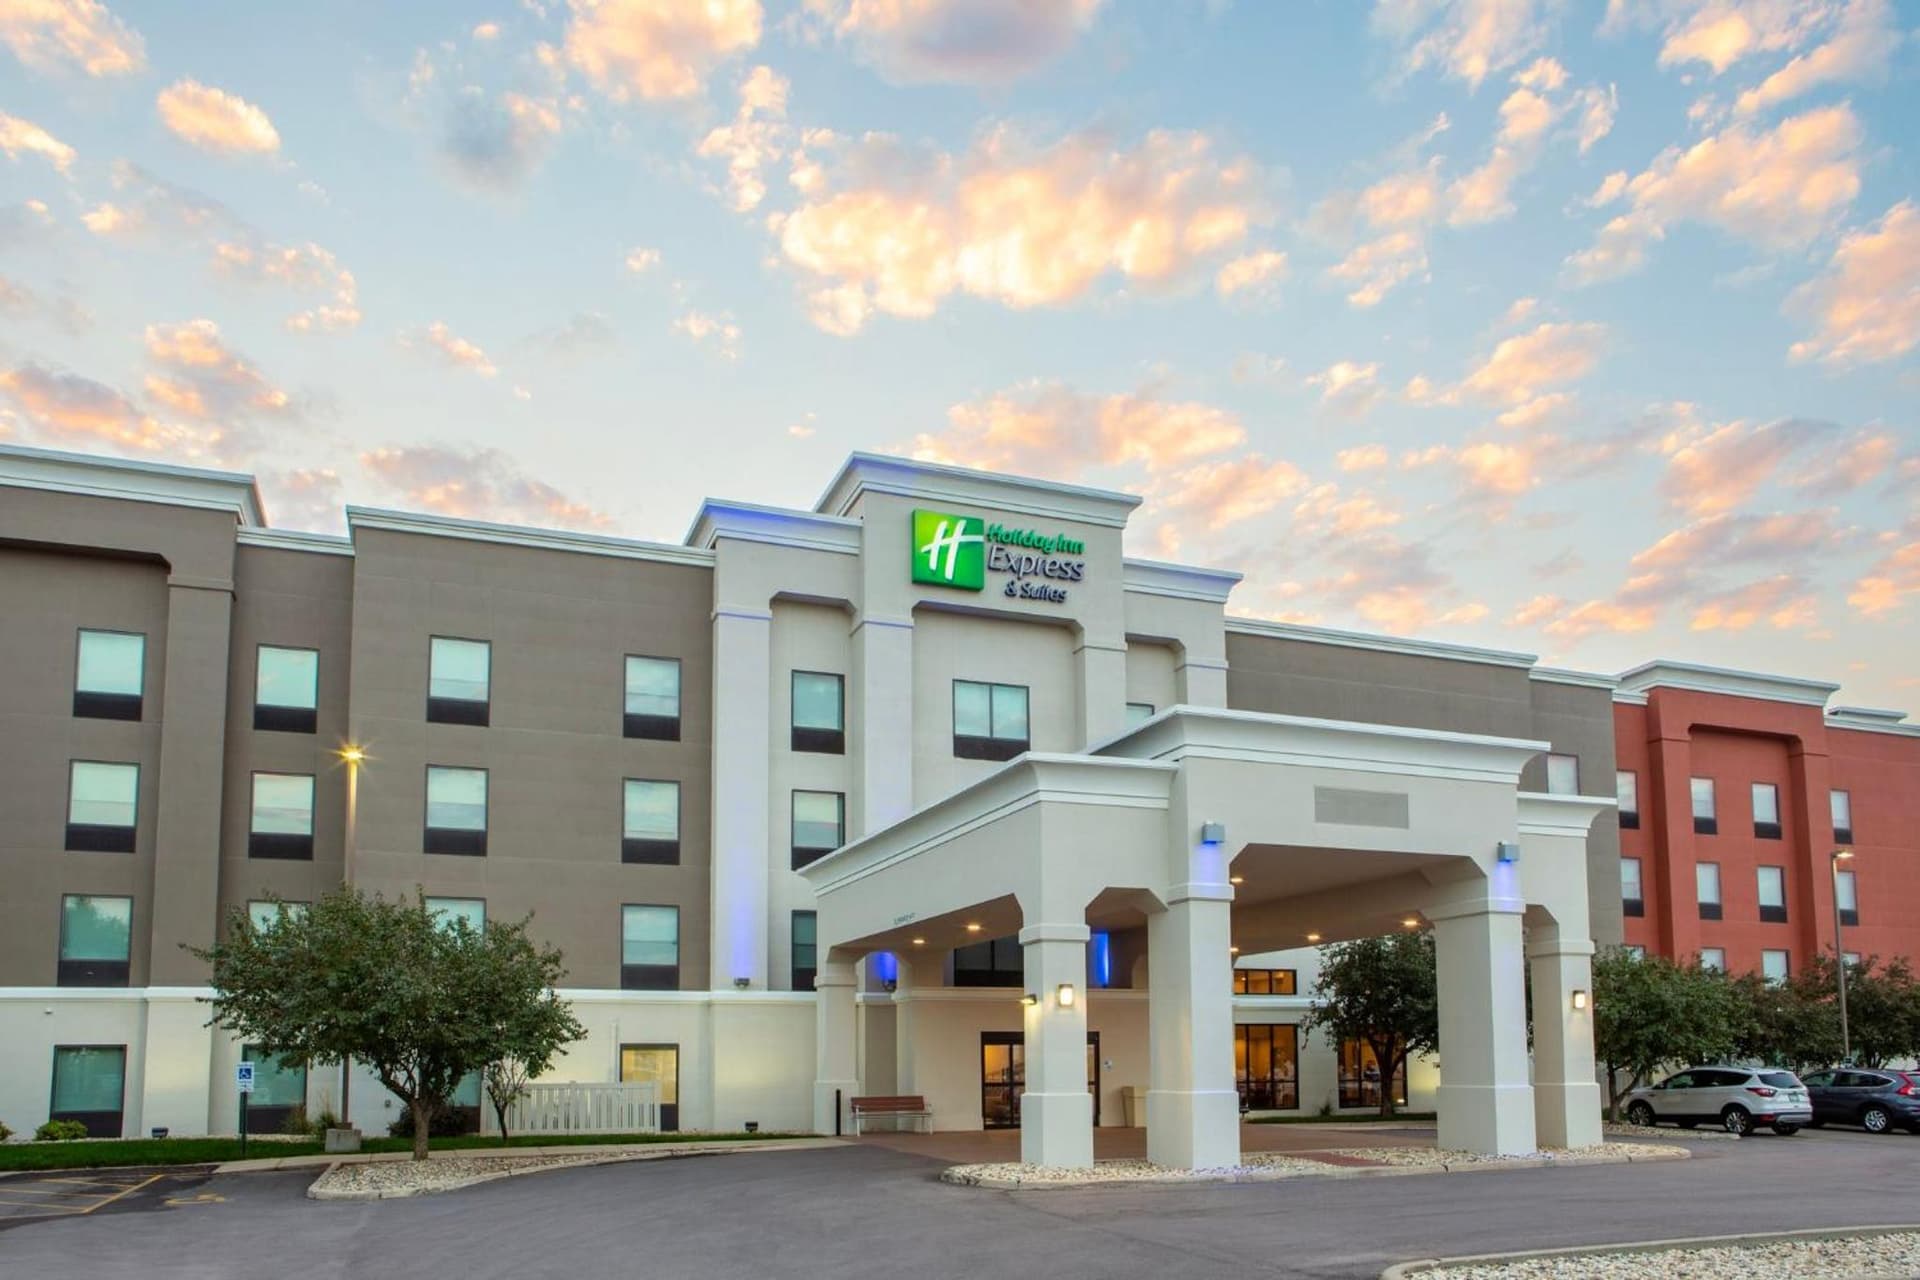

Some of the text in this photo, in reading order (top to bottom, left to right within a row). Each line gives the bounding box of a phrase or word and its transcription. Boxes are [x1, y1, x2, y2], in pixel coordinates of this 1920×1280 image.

[987, 524, 1085, 555] Holiday Inn
[988, 545, 1085, 582] Express
[1004, 580, 1067, 603] & Suites
